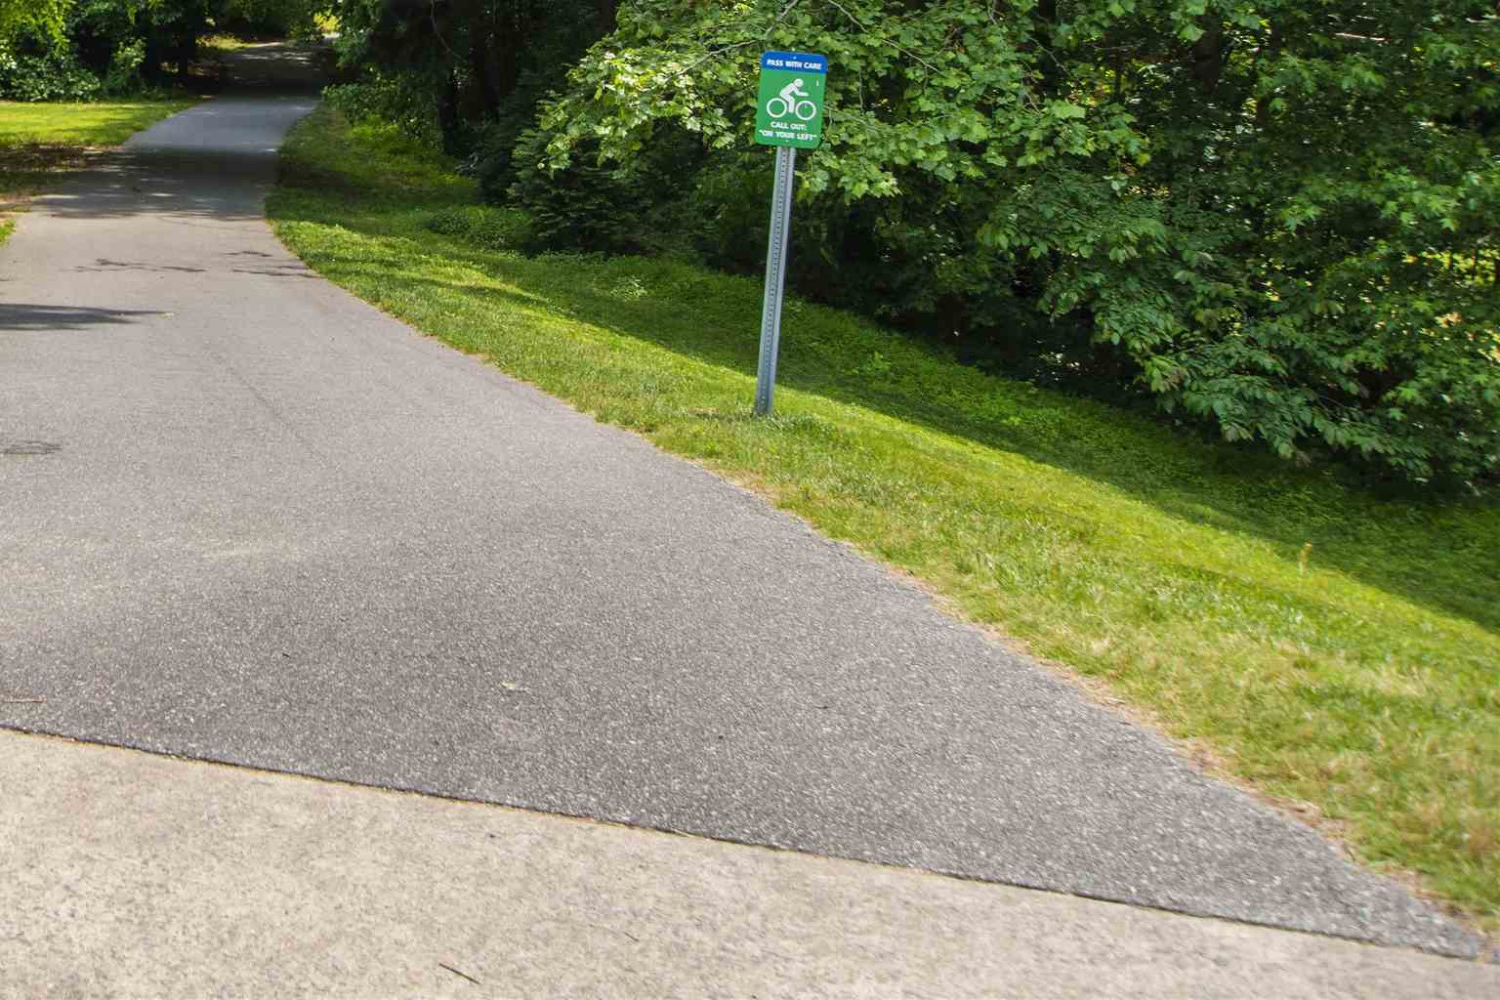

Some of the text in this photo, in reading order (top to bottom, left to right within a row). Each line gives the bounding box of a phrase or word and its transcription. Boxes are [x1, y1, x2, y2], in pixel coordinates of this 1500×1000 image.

[766, 59, 783, 67] PASS
[804, 62, 822, 70] CARE
[770, 121, 789, 129] CALL
[775, 131, 795, 139] YOUR
